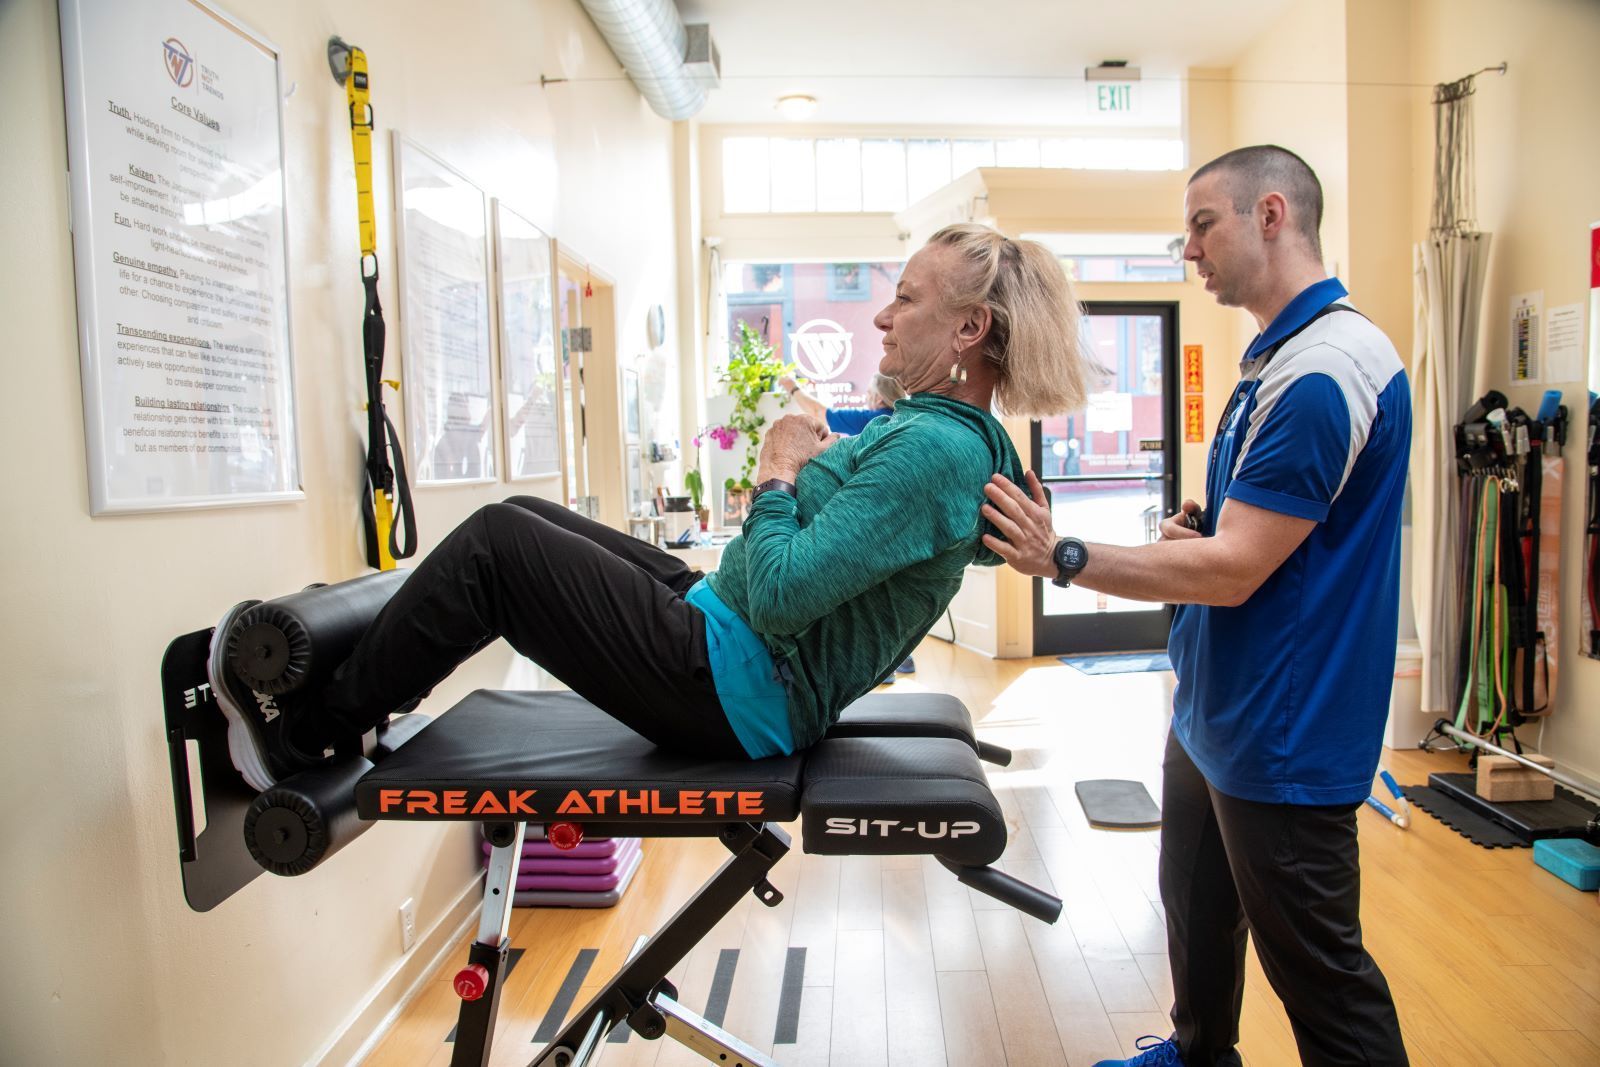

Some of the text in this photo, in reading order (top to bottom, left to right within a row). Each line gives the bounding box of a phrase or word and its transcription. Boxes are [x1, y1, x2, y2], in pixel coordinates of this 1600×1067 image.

[202, 82, 224, 100] TRENDS
[1098, 84, 1132, 111] EXIT
[133, 112, 160, 133] Holding
[170, 96, 221, 131] Core Values
[126, 126, 144, 140] while
[145, 134, 169, 152] leaving
[157, 174, 170, 188] The
[120, 191, 130, 203] be
[132, 196, 159, 212] attained
[133, 218, 151, 232] Hard
[152, 227, 167, 238] work
[113, 251, 146, 271] Genuine
[119, 269, 130, 280] life
[132, 272, 141, 283] for
[150, 278, 173, 290] chance
[182, 286, 214, 300] experience
[141, 289, 173, 308] Choosing
[187, 316, 199, 326] and
[116, 322, 168, 343] Transcending
[212, 340, 224, 350] The
[224, 344, 239, 353] world
[117, 341, 161, 357] experiences
[161, 345, 174, 357] that
[175, 349, 187, 358] can
[188, 350, 199, 361] feel
[200, 352, 211, 362] like
[117, 357, 145, 370] actively
[146, 360, 163, 369] seek
[164, 363, 204, 376] opportunities
[174, 379, 194, 389] create
[194, 381, 215, 391] deeper
[135, 396, 166, 409] Building
[166, 399, 190, 411] lasting
[133, 411, 173, 423] relationship
[174, 415, 188, 425] gets
[189, 415, 206, 424] richer
[123, 427, 156, 437] beneficial
[158, 429, 197, 439] relationships
[198, 429, 221, 439] benefits
[135, 443, 147, 453] but
[148, 445, 157, 453] as
[158, 444, 189, 453] members
[252, 689, 280, 723] KA
[380, 789, 764, 815] FREAK ATHLETE
[825, 817, 981, 839] SIT-UP
